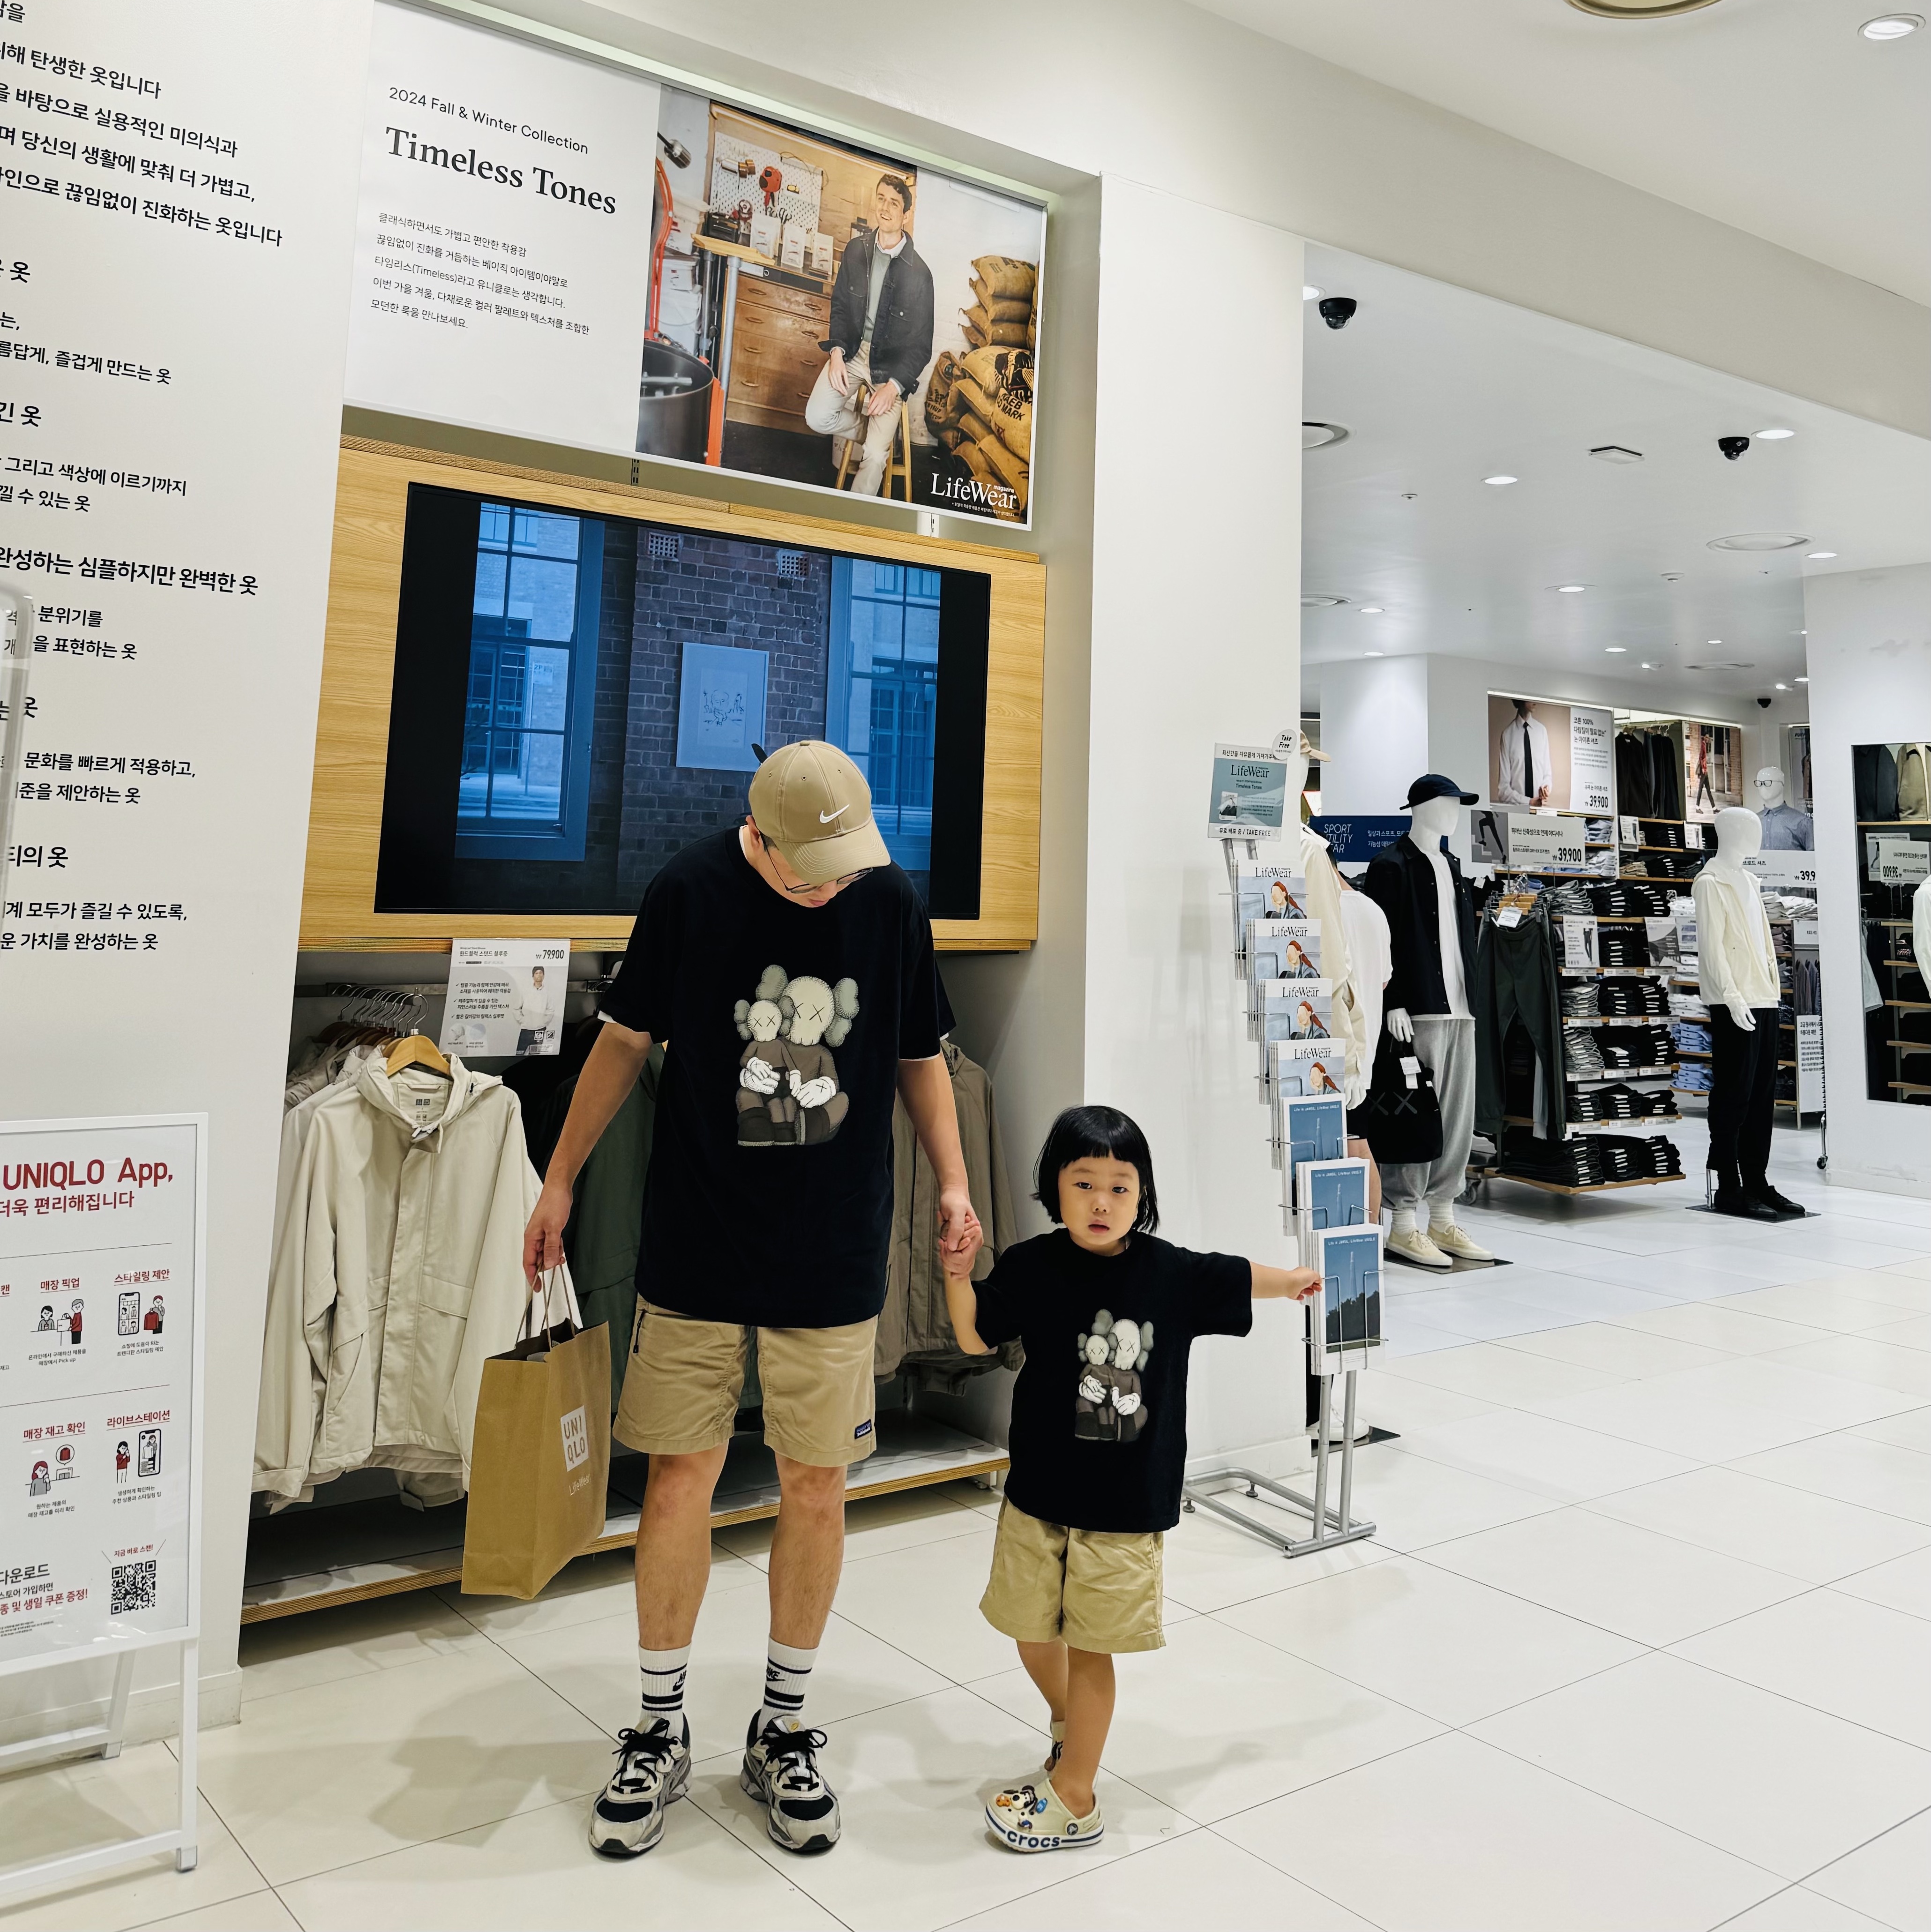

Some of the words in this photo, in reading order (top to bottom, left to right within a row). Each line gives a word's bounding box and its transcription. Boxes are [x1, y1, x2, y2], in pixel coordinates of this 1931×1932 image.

[31, 50, 86, 80] 탄생한
[90, 67, 161, 99] 옷입니다
[16, 89, 89, 120] 바탕으로
[95, 108, 164, 140] 실용적인
[170, 127, 238, 157] 미의식과
[389, 87, 426, 106] 2024
[432, 97, 454, 115] Fall
[459, 106, 468, 120] &
[472, 110, 517, 133] Winter
[522, 125, 587, 154] Collection
[22, 131, 76, 160] 당신의
[82, 146, 135, 173] 생활에
[141, 159, 174, 182] 맞춰
[180, 169, 195, 187] 더
[201, 174, 254, 202] 가볍고,
[386, 127, 523, 187] Timeless
[533, 167, 615, 214] Tones
[65, 183, 136, 215] 끊임없이
[142, 200, 211, 231] 진화하는
[215, 217, 282, 247] 옷입니다
[379, 213, 442, 235] 클래식하면서도
[445, 229, 471, 242] 가볍고
[473, 236, 499, 250] 편안한
[502, 243, 526, 257] 착용감
[377, 234, 413, 251] 끊임없이
[417, 243, 442, 258] 진화를
[446, 251, 479, 267] 거듭하는
[482, 260, 508, 274] 베이직
[510, 267, 568, 287] 아이템이야말로
[10, 262, 30, 283] 옷
[375, 256, 474, 286] 타임리스(Timeless)라고
[477, 280, 519, 298] 유니클로는
[522, 291, 565, 308] 생각합니다.
[371, 300, 399, 313] 모던한
[401, 306, 419, 318] 룩을
[422, 310, 468, 328] 만나보세요.
[374, 278, 391, 290] 이번
[395, 282, 412, 294] 가을
[415, 287, 434, 300] 겨울,
[438, 292, 472, 308] 다채로운
[476, 300, 492, 313] 컬러
[495, 305, 528, 321] 팔레트와
[531, 313, 563, 329] 텍스처를
[565, 322, 589, 335] 조합한
[55, 351, 102, 373] 즐겁게
[107, 360, 152, 381] 만드는
[156, 369, 171, 384] 옷
[21, 406, 41, 427] 옷
[1001, 403, 1025, 420] MARK
[5, 457, 54, 476] 그리고
[59, 464, 106, 485] 색상에
[111, 472, 186, 496] 이르기까지
[17, 488, 34, 504] 수
[39, 491, 70, 509] 있는
[75, 496, 90, 512] 옷
[930, 473, 1017, 509] LifeWear
[78, 557, 176, 586] 심플하지만
[179, 569, 236, 593] 완벽한
[240, 576, 258, 595] 옷
[38, 606, 103, 627] 분위기를
[52, 638, 117, 658] 표현하는
[121, 644, 137, 660] 옷
[24, 752, 74, 771] 문화를
[78, 756, 126, 773] 빠르게
[130, 758, 195, 778] 적용하고,
[1231, 764, 1269, 778] LifeWear
[56, 785, 121, 803] 제안하는
[125, 788, 141, 804] 옷
[1324, 824, 1352, 833] SPORT
[1326, 834, 1353, 844] TILITY
[47, 847, 68, 868] 옷
[1256, 867, 1292, 878] LifeWear
[26, 902, 77, 919] 모두가
[81, 903, 112, 920] 즐길
[116, 904, 133, 920] 수
[138, 904, 187, 921] 있도록,
[21, 933, 70, 950] 가치를
[74, 933, 138, 950] 완성하는
[142, 934, 158, 950] 옷
[1272, 927, 1308, 937] LifeWear
[1282, 987, 1319, 998] LifeWear
[1295, 1048, 1332, 1060] LifeWear
[3, 1159, 104, 1190] UNIQLO
[117, 1157, 172, 1188] App,
[0, 1199, 29, 1217] 더욱
[34, 1191, 135, 1214] 편리해집니다
[41, 1280, 59, 1290] 매장
[62, 1278, 79, 1288] 픽업
[114, 1271, 149, 1282] 스타일링
[152, 1269, 170, 1279] 제안
[107, 1410, 170, 1427] 라이브스테이션
[563, 1415, 583, 1439] UNI
[24, 1427, 43, 1439] 매장
[45, 1425, 64, 1436] 재고
[67, 1422, 85, 1433] 확인
[567, 1436, 585, 1464] QLO
[12, 1601, 20, 1612] 및
[24, 1597, 42, 1610] 생일
[45, 1593, 64, 1606] 쿠폰
[67, 1588, 87, 1602] 증정!
[23, 1582, 53, 1595] 가입하면
[1007, 1831, 1060, 1848] crocs
